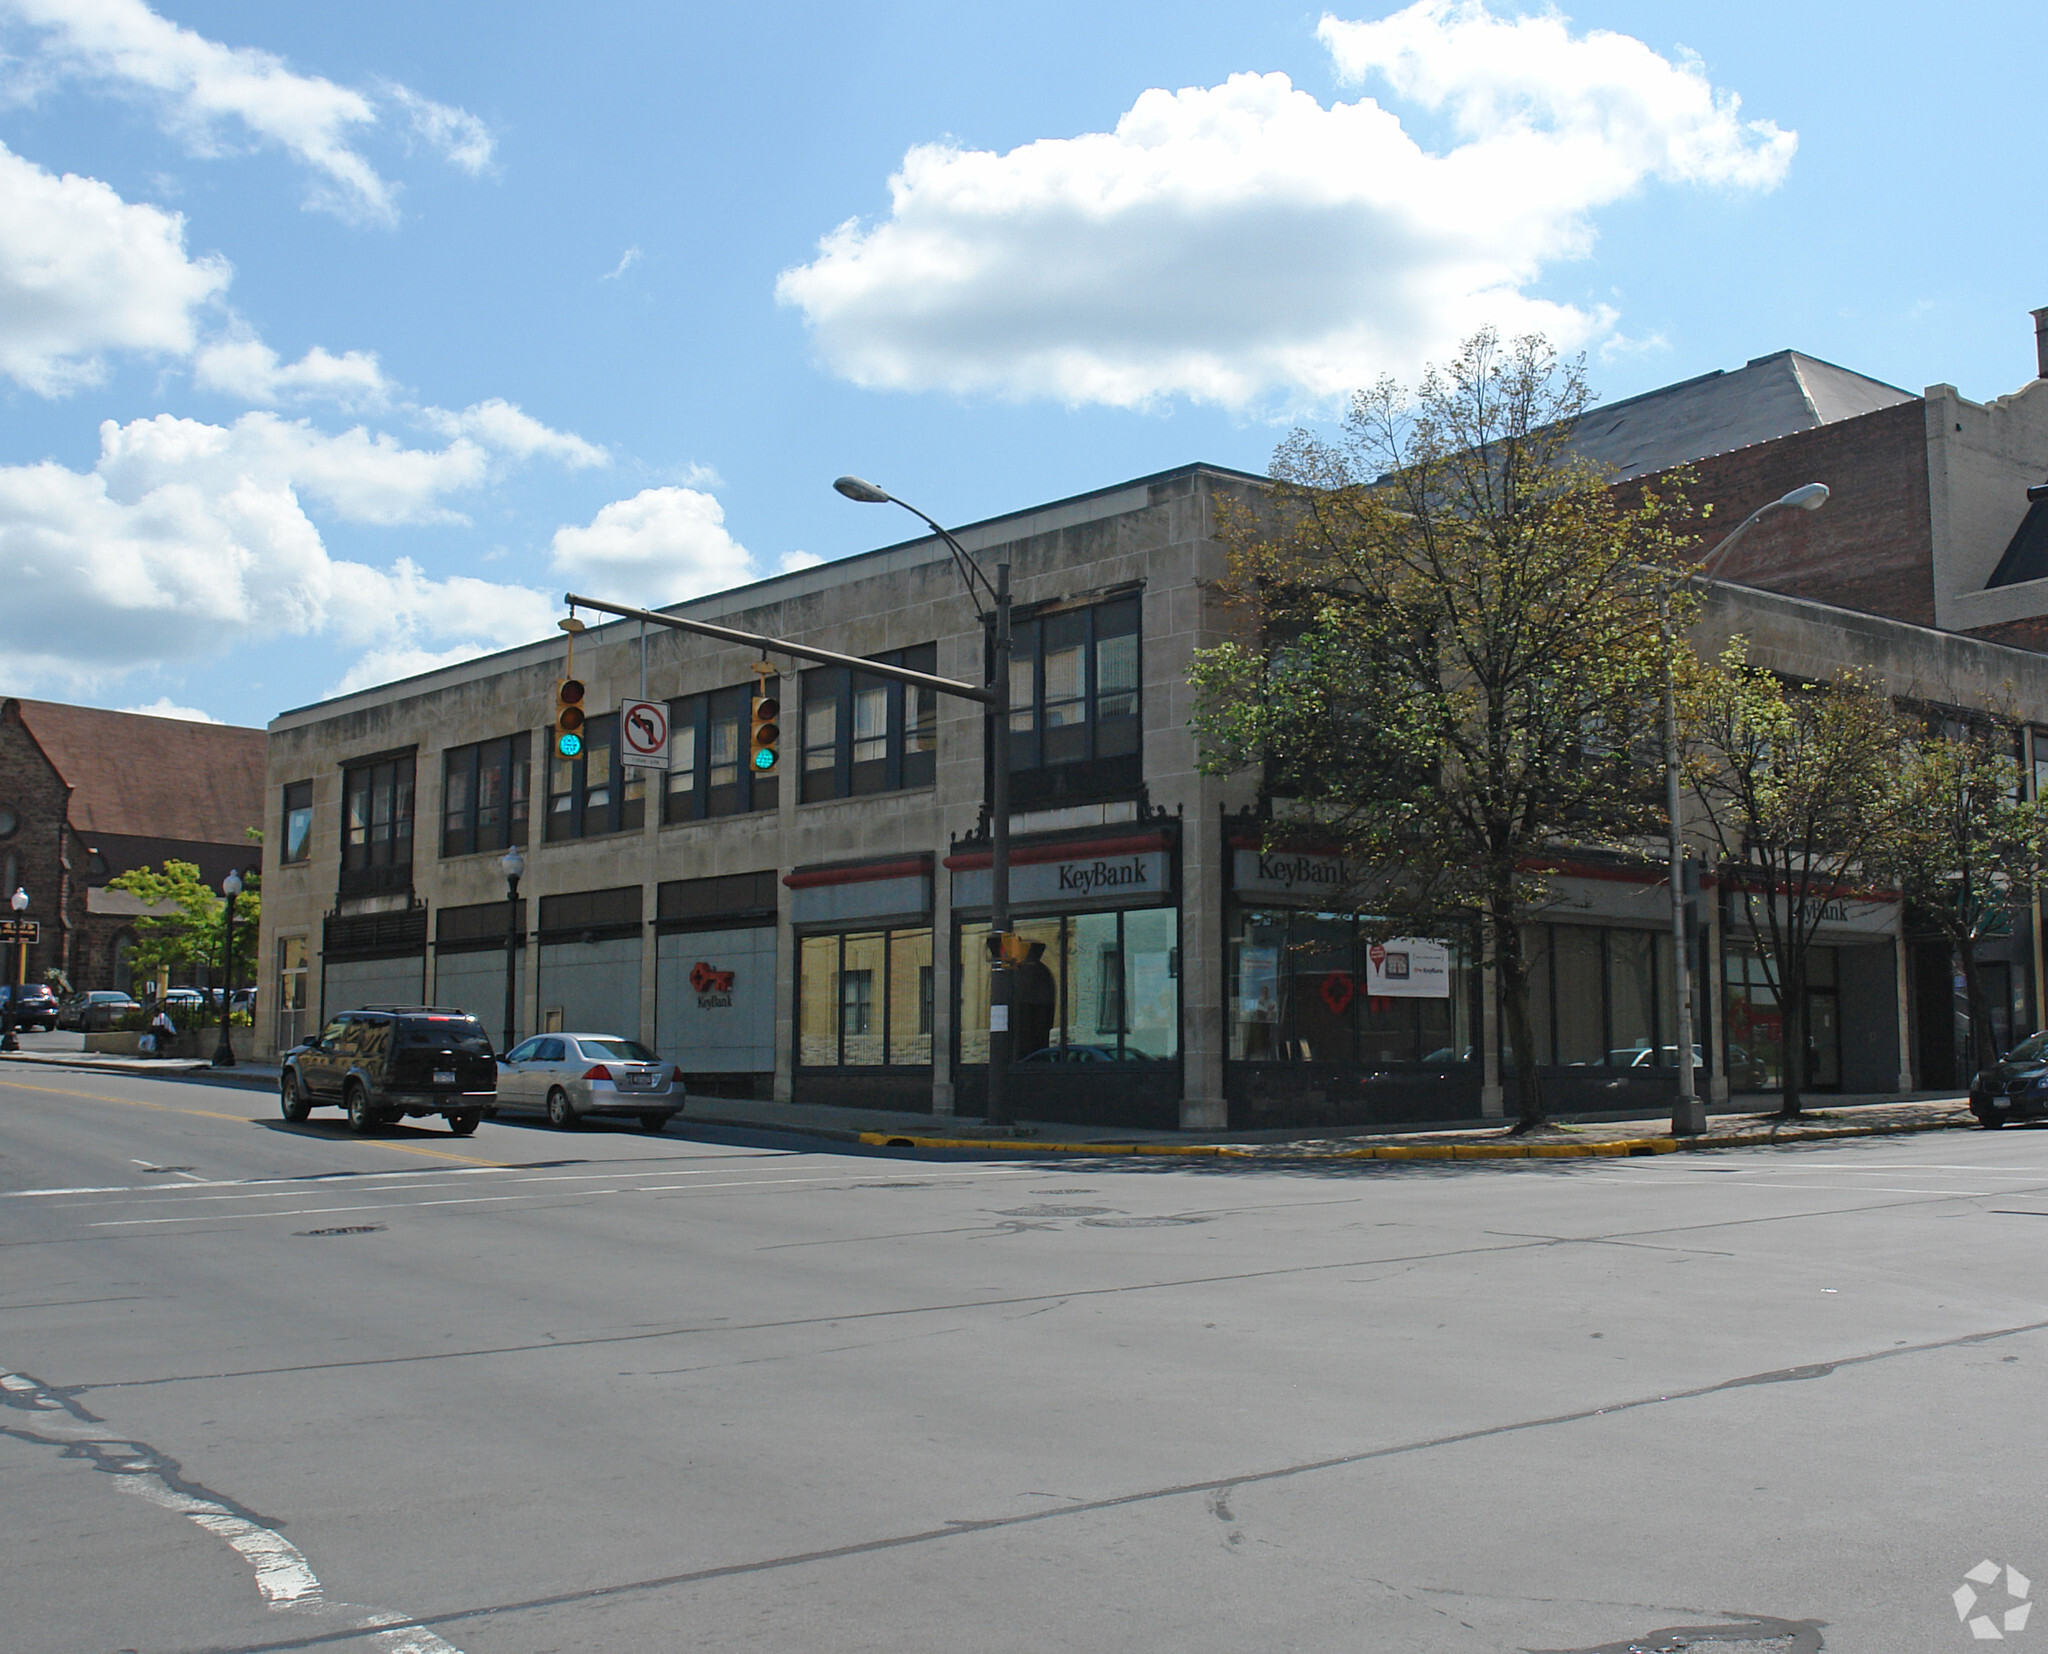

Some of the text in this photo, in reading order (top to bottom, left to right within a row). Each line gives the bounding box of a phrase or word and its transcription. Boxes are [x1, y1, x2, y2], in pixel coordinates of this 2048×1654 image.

[1058, 857, 1147, 895] KeyBank
[1257, 854, 1350, 888] KeyBank
[1788, 898, 1849, 925] yBank
[698, 995, 732, 1011] KeyBank
